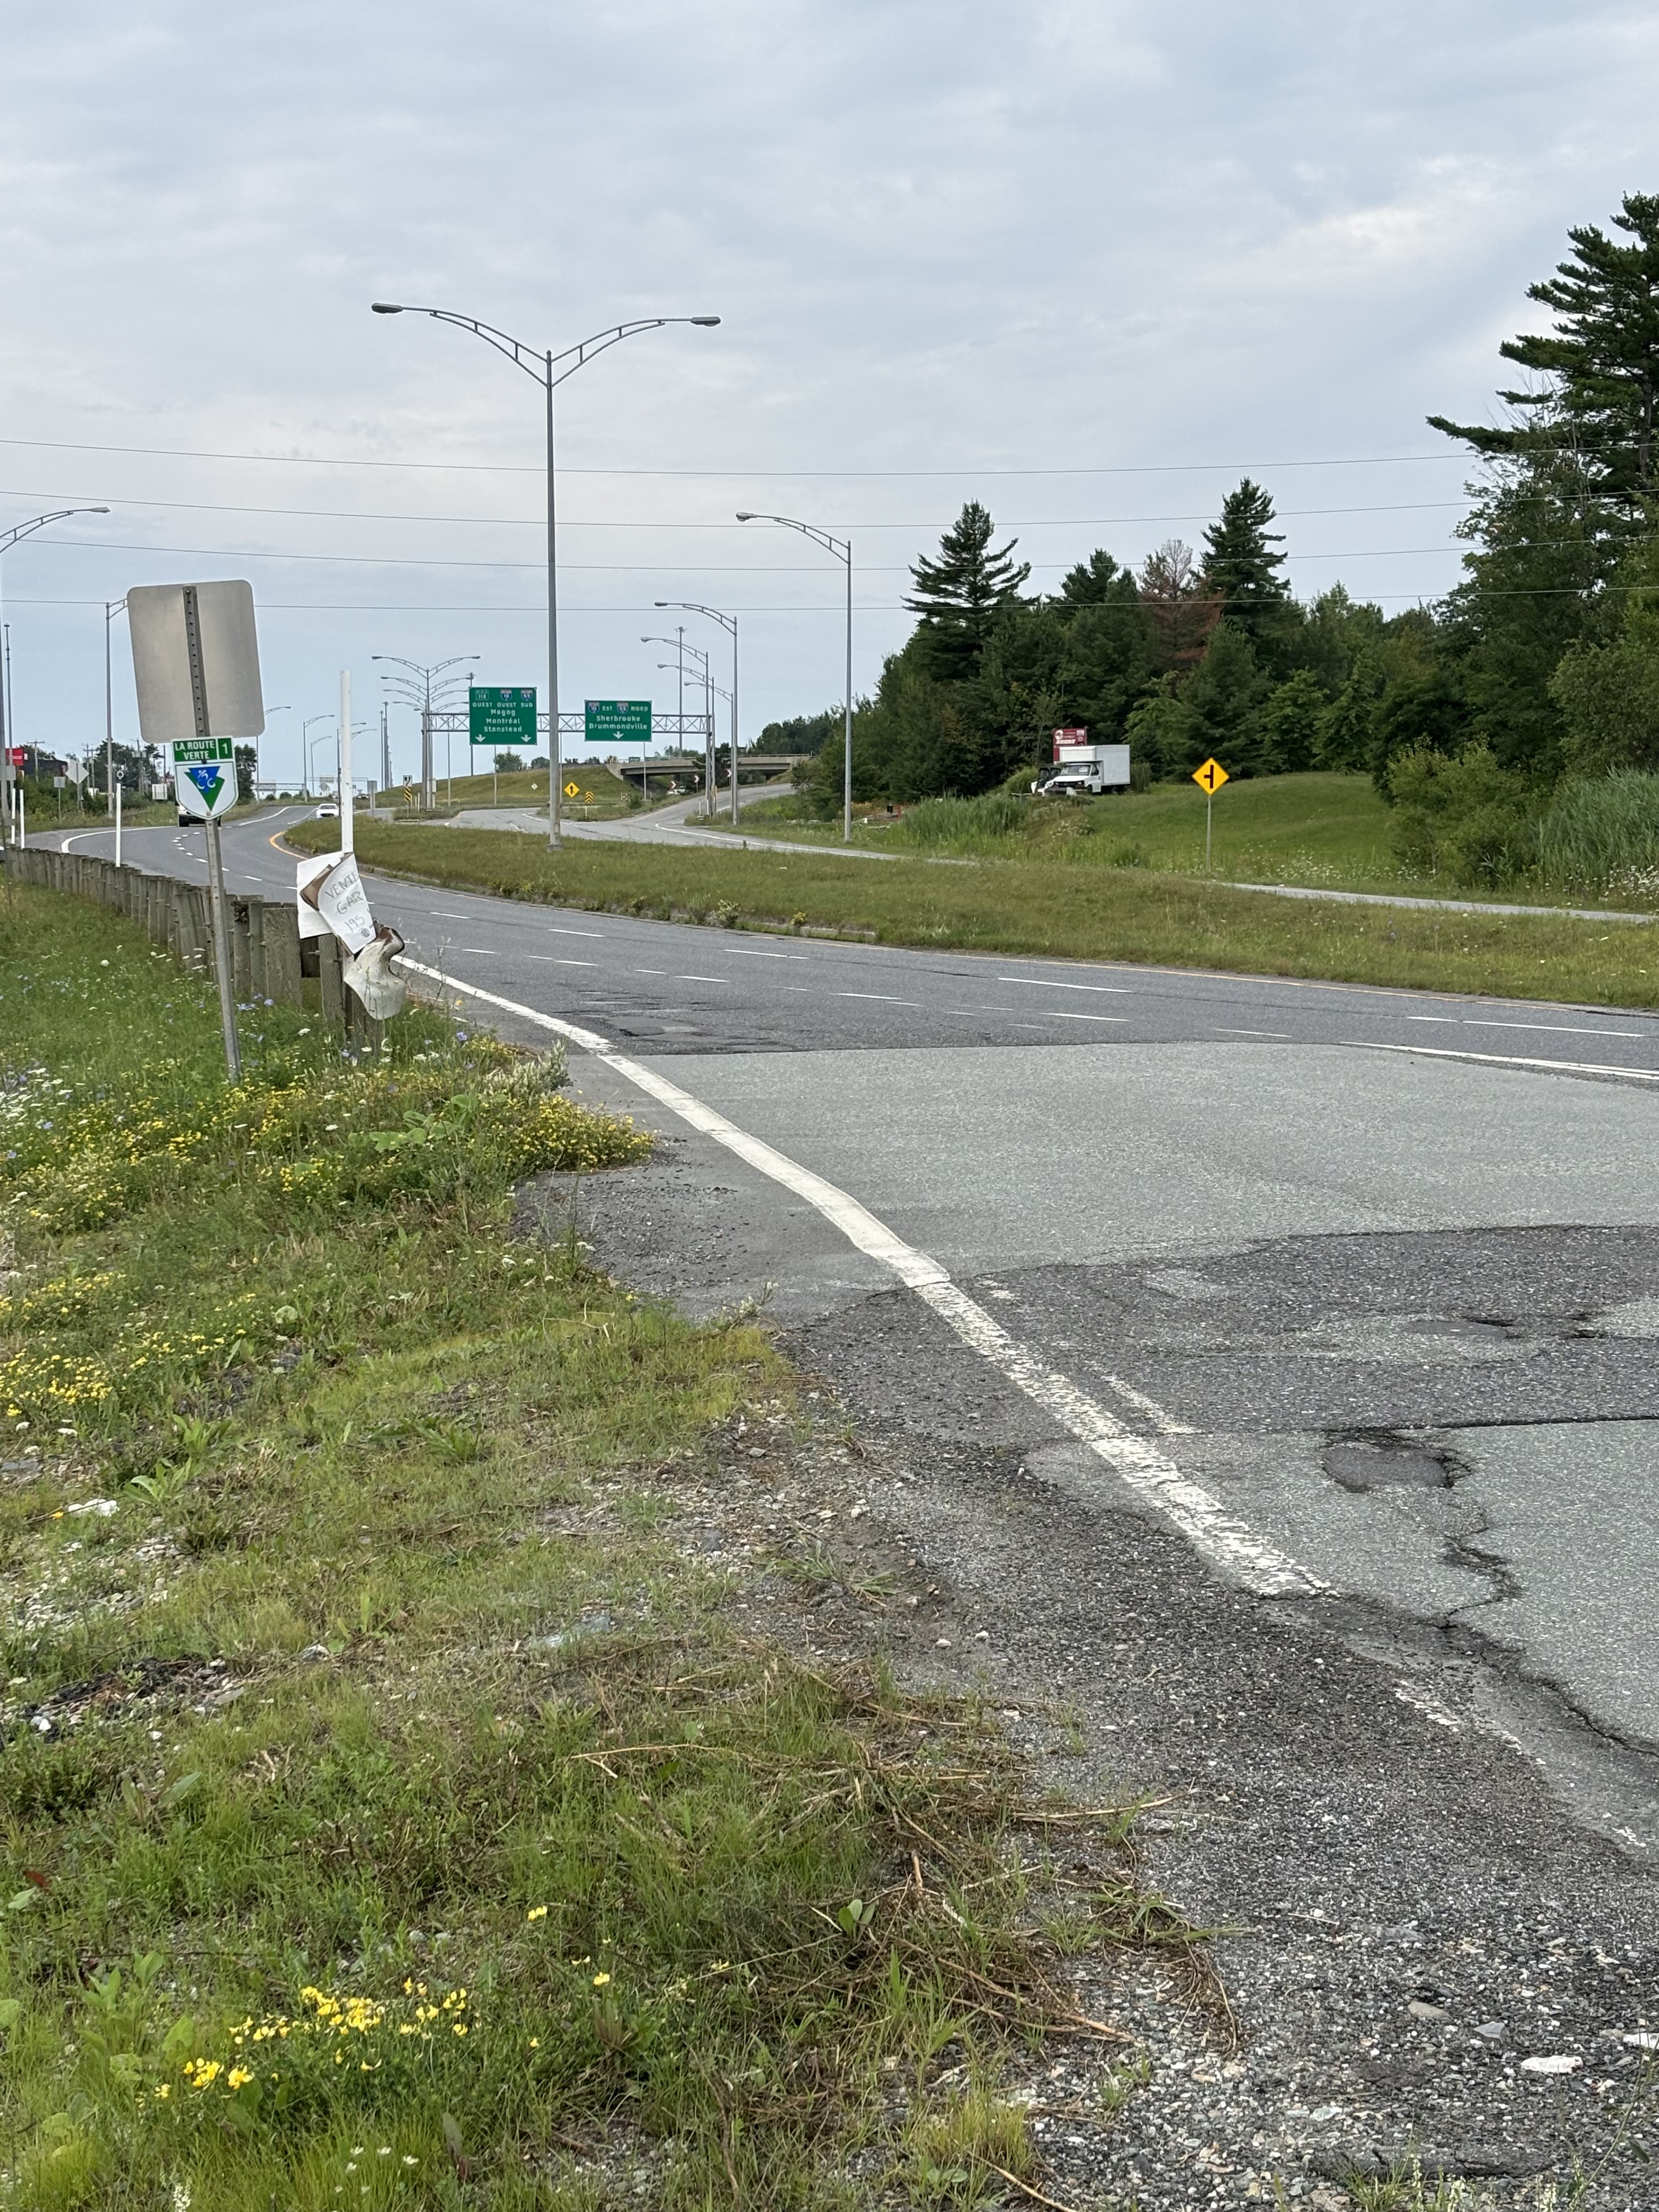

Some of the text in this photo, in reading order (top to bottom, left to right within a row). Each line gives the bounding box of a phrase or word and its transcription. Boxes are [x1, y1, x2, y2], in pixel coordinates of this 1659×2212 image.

[174, 740, 215, 751] LA ROUTE
[222, 742, 228, 754] 1
[183, 751, 210, 760] VERTE
